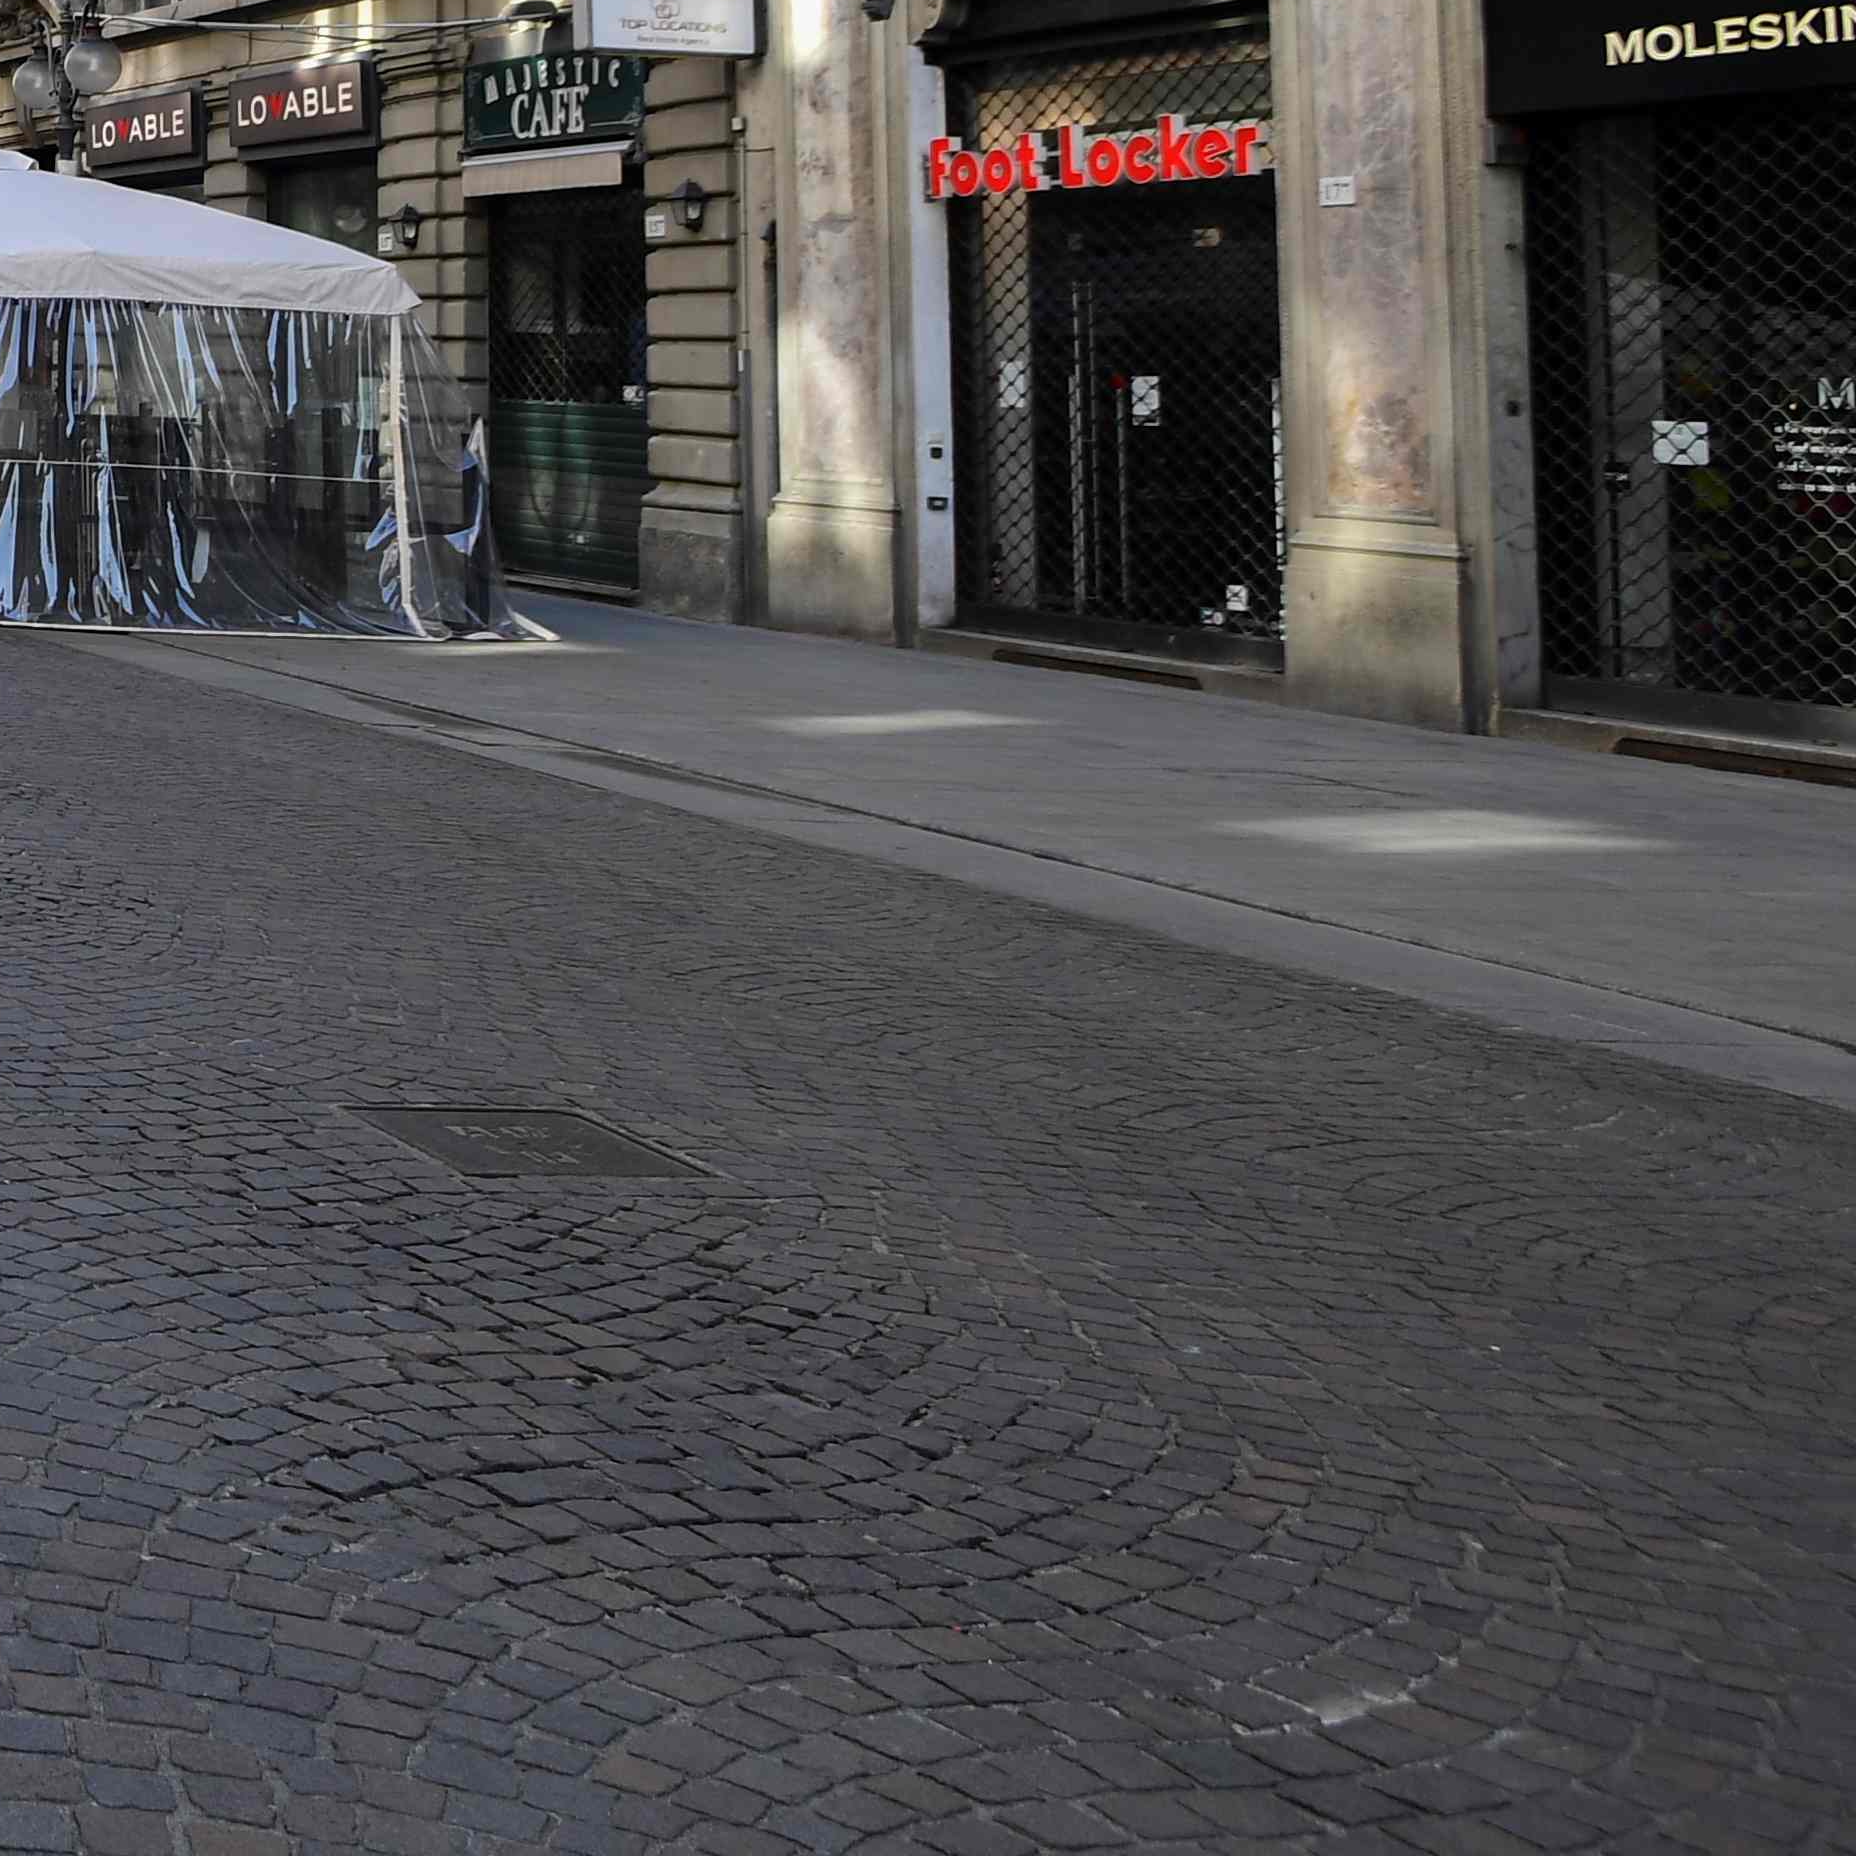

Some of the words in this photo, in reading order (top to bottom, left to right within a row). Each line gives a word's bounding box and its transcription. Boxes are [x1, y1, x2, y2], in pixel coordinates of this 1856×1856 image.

[484, 57, 621, 105] MAJESTIC
[928, 132, 1040, 200] Foot
[1056, 113, 1259, 190] Locker
